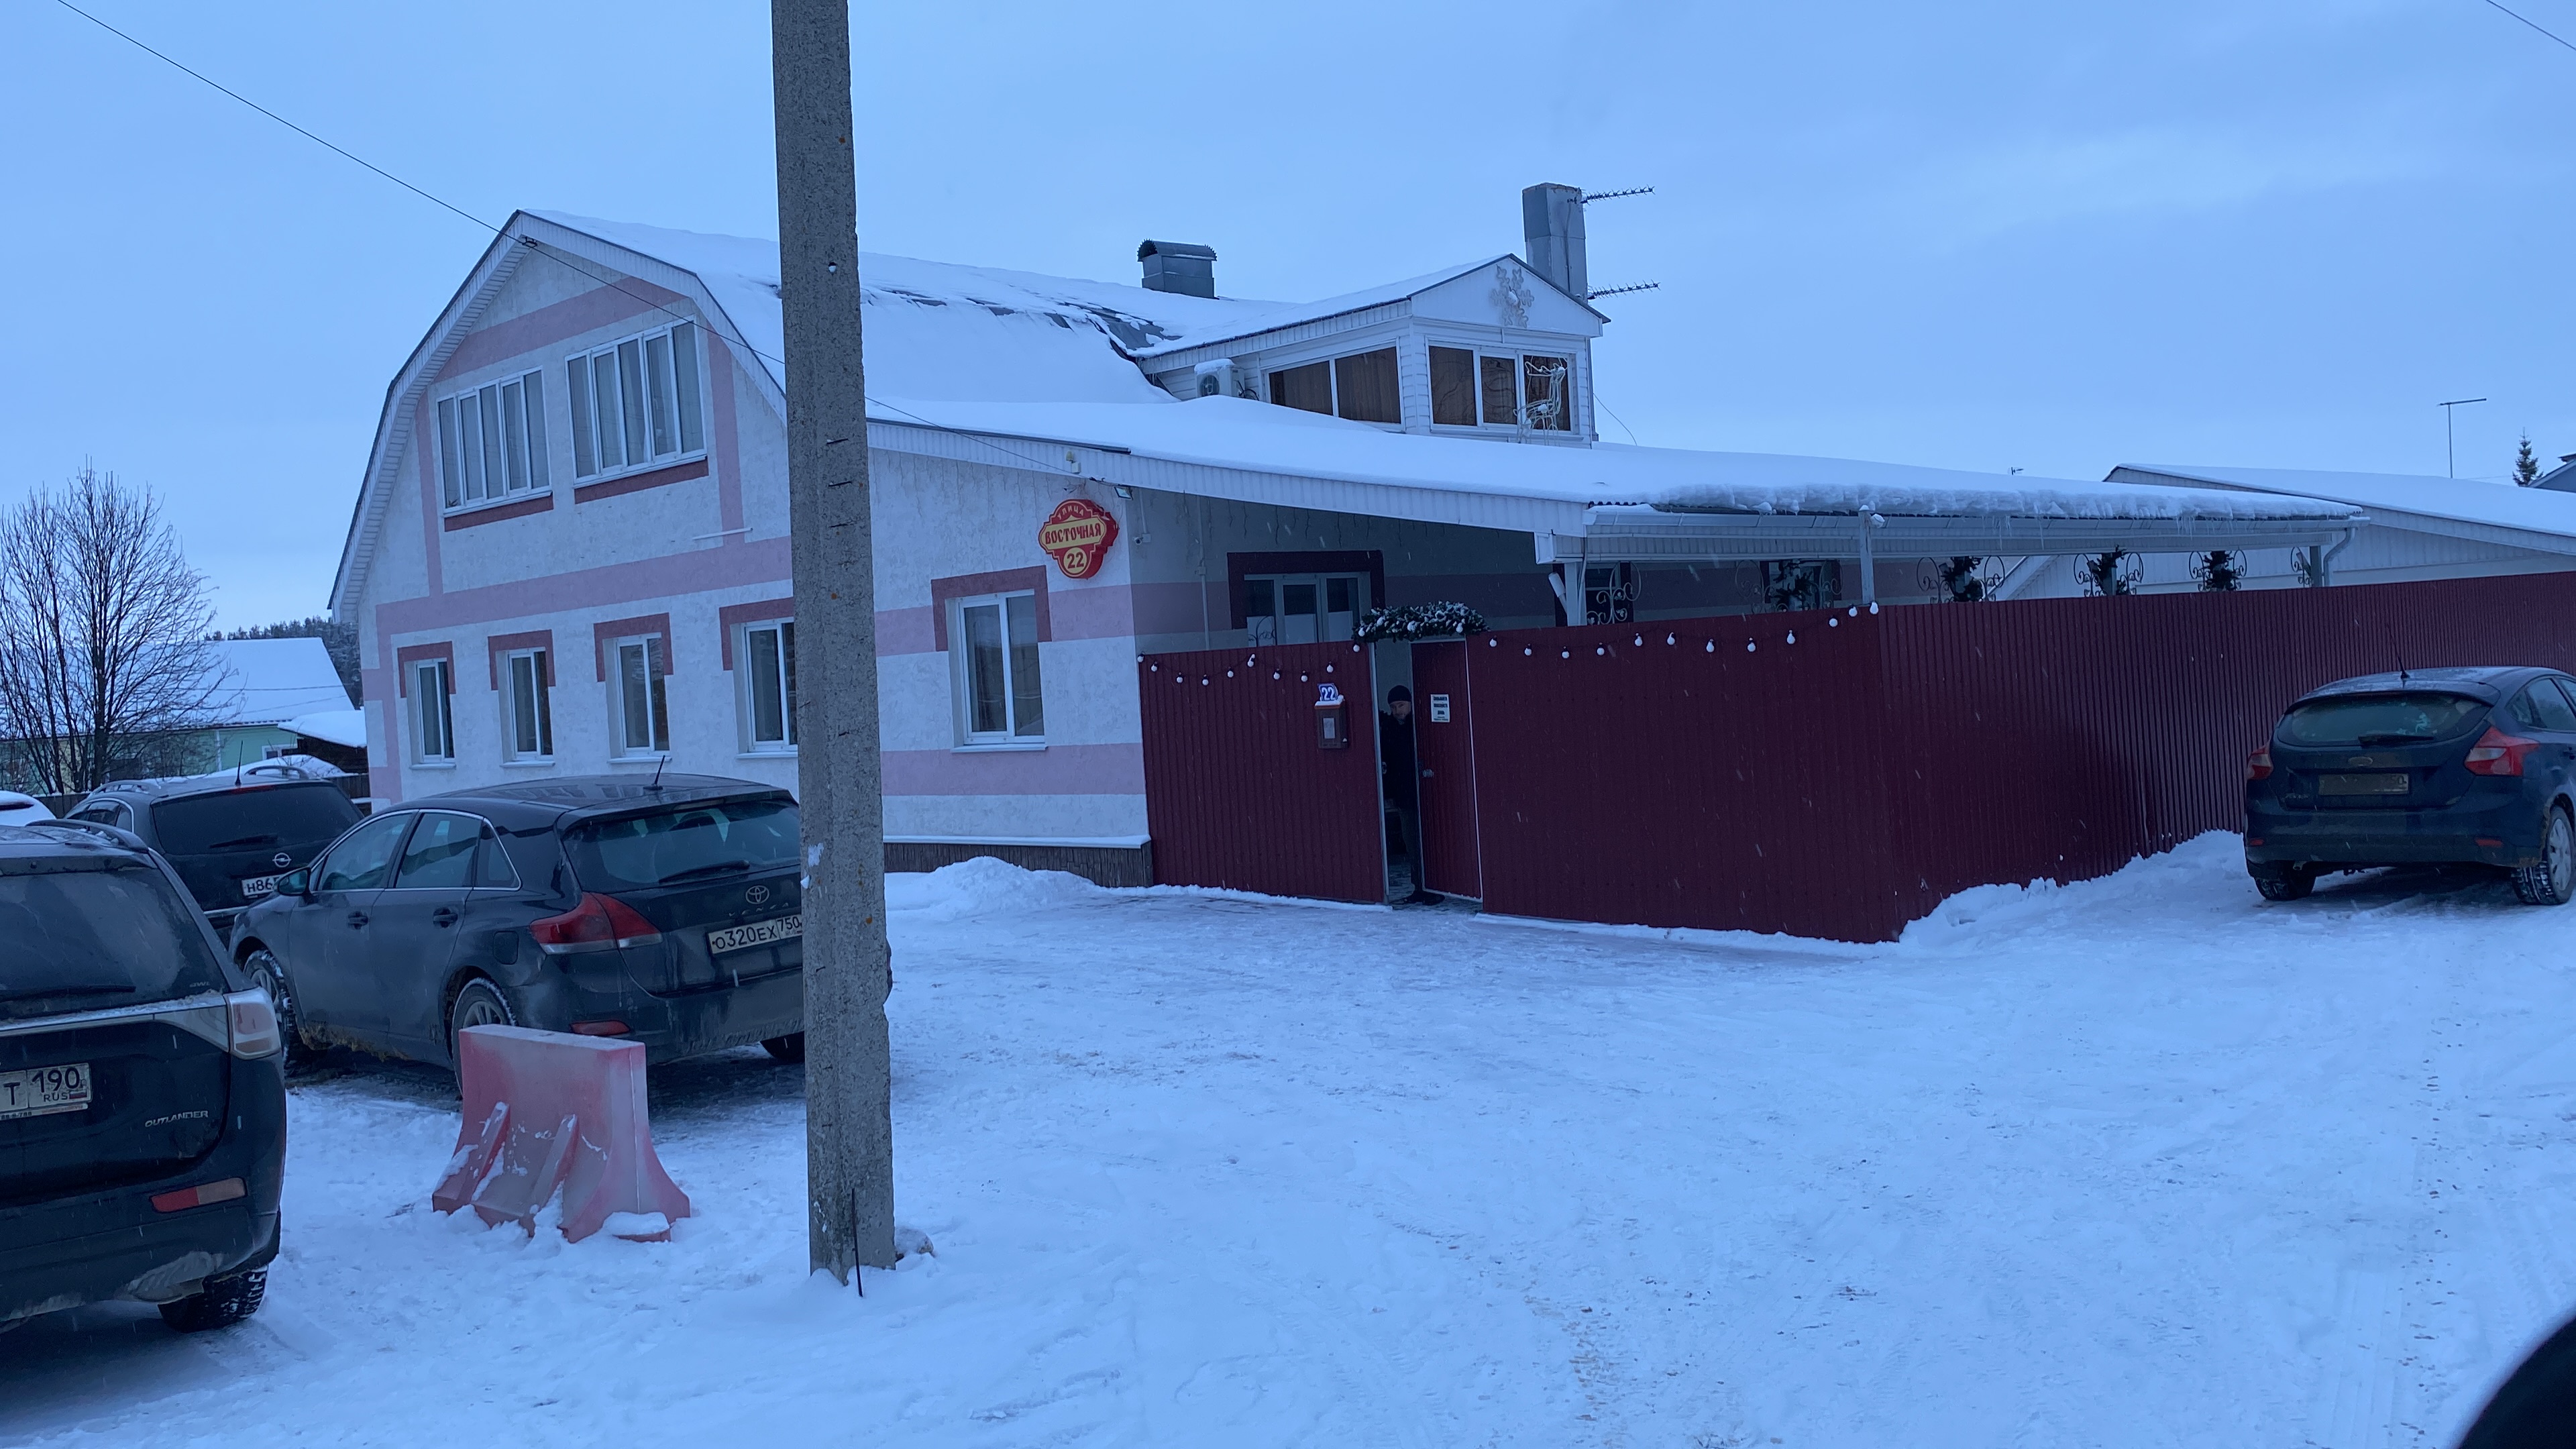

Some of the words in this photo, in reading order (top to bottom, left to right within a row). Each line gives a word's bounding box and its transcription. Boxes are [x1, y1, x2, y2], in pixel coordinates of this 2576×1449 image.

[1057, 505, 1084, 520] УЛИЦА
[1045, 523, 1102, 545] ВОСТОЧНАЯ
[1067, 551, 1084, 569] 22
[1322, 686, 1336, 700] 22
[777, 916, 800, 931] 750
[32, 1067, 80, 1093] 190
[44, 1092, 68, 1102] RUS
[145, 1110, 209, 1128] OUTLANDER
